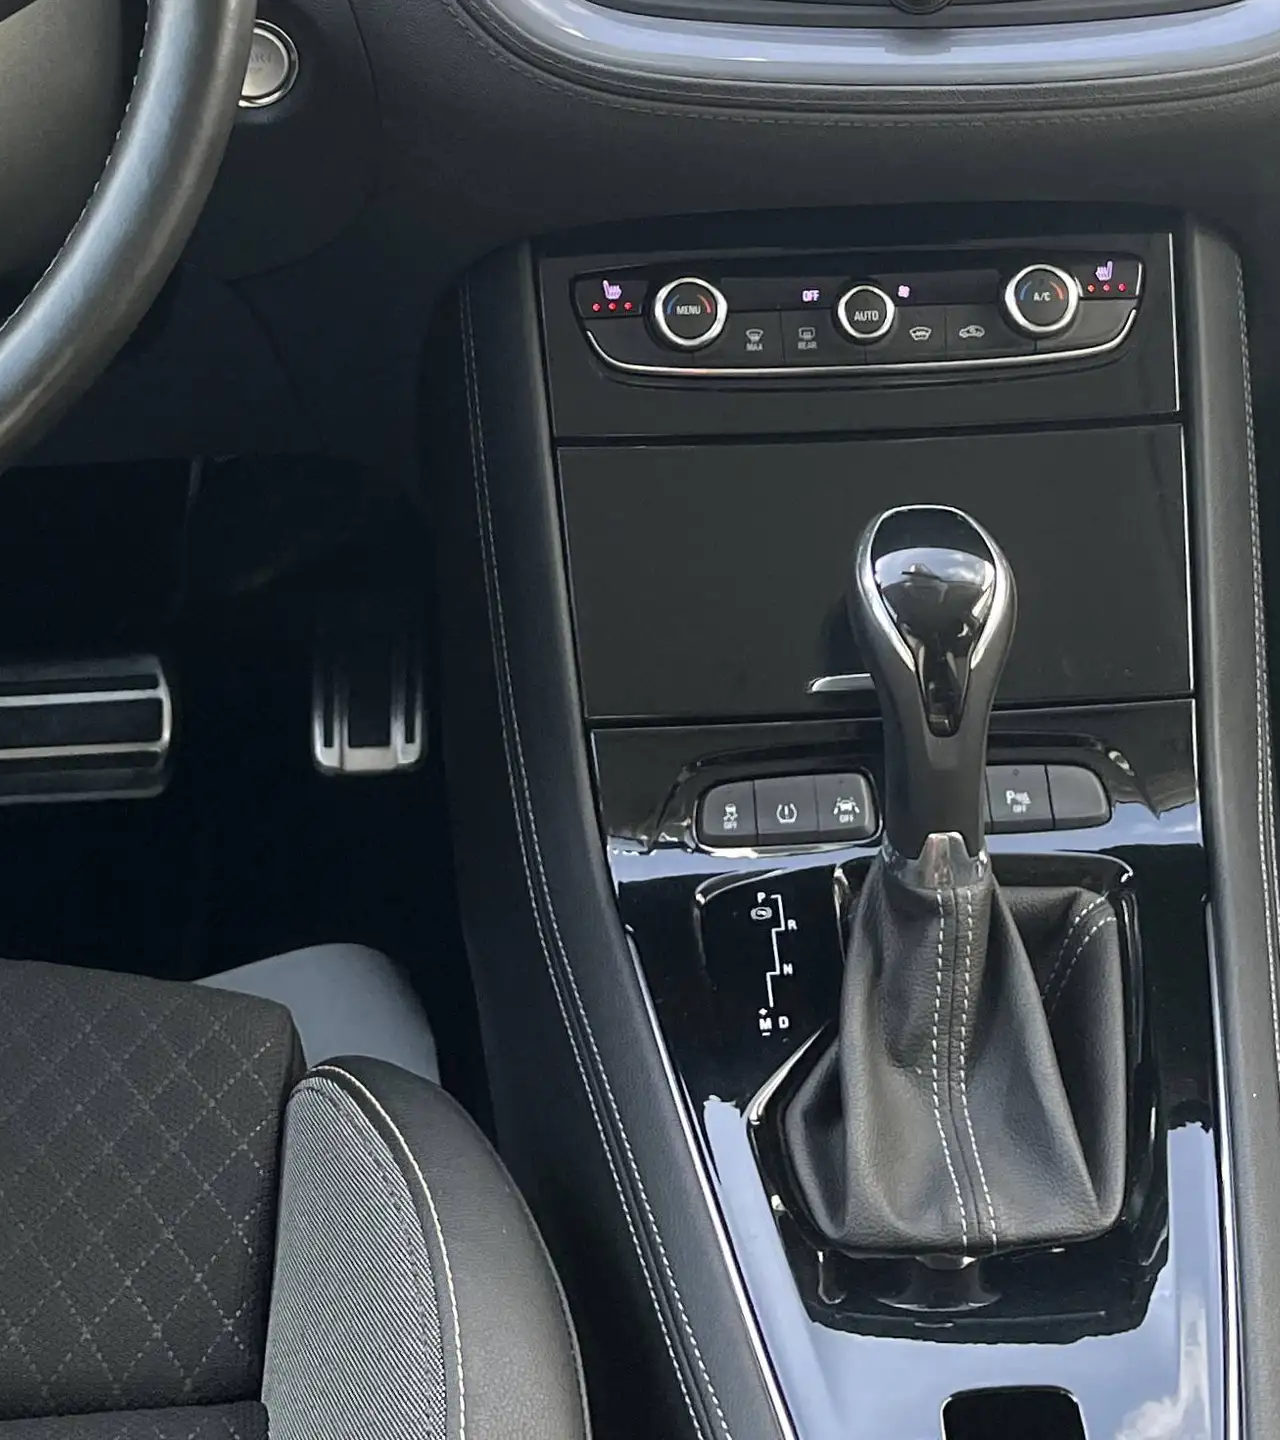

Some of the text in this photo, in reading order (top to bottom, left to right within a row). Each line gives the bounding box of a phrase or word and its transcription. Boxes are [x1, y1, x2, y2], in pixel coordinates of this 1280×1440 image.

[802, 289, 820, 302] OFF
[1033, 293, 1051, 302] A/C
[676, 304, 701, 316] MENU
[854, 310, 879, 322] AUTO
[757, 892, 766, 903] P
[787, 919, 798, 931] R
[783, 963, 793, 976] N
[759, 1016, 789, 1030] M D
